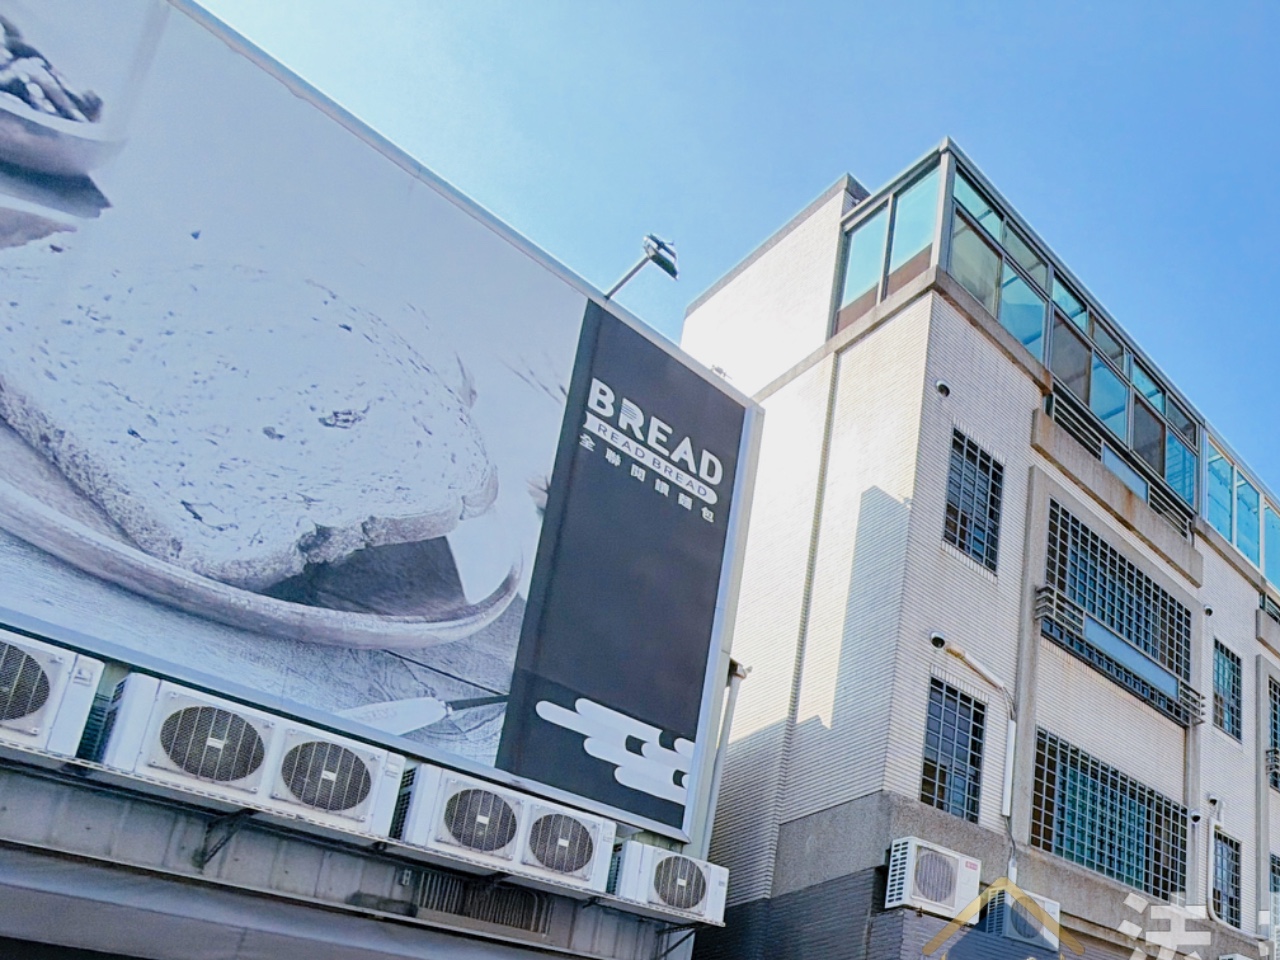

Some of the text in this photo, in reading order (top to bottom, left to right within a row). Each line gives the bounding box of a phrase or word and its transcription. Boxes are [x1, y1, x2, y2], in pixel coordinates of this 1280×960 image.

[586, 377, 723, 486] BREAD
[597, 423, 707, 497] READ BREAD
